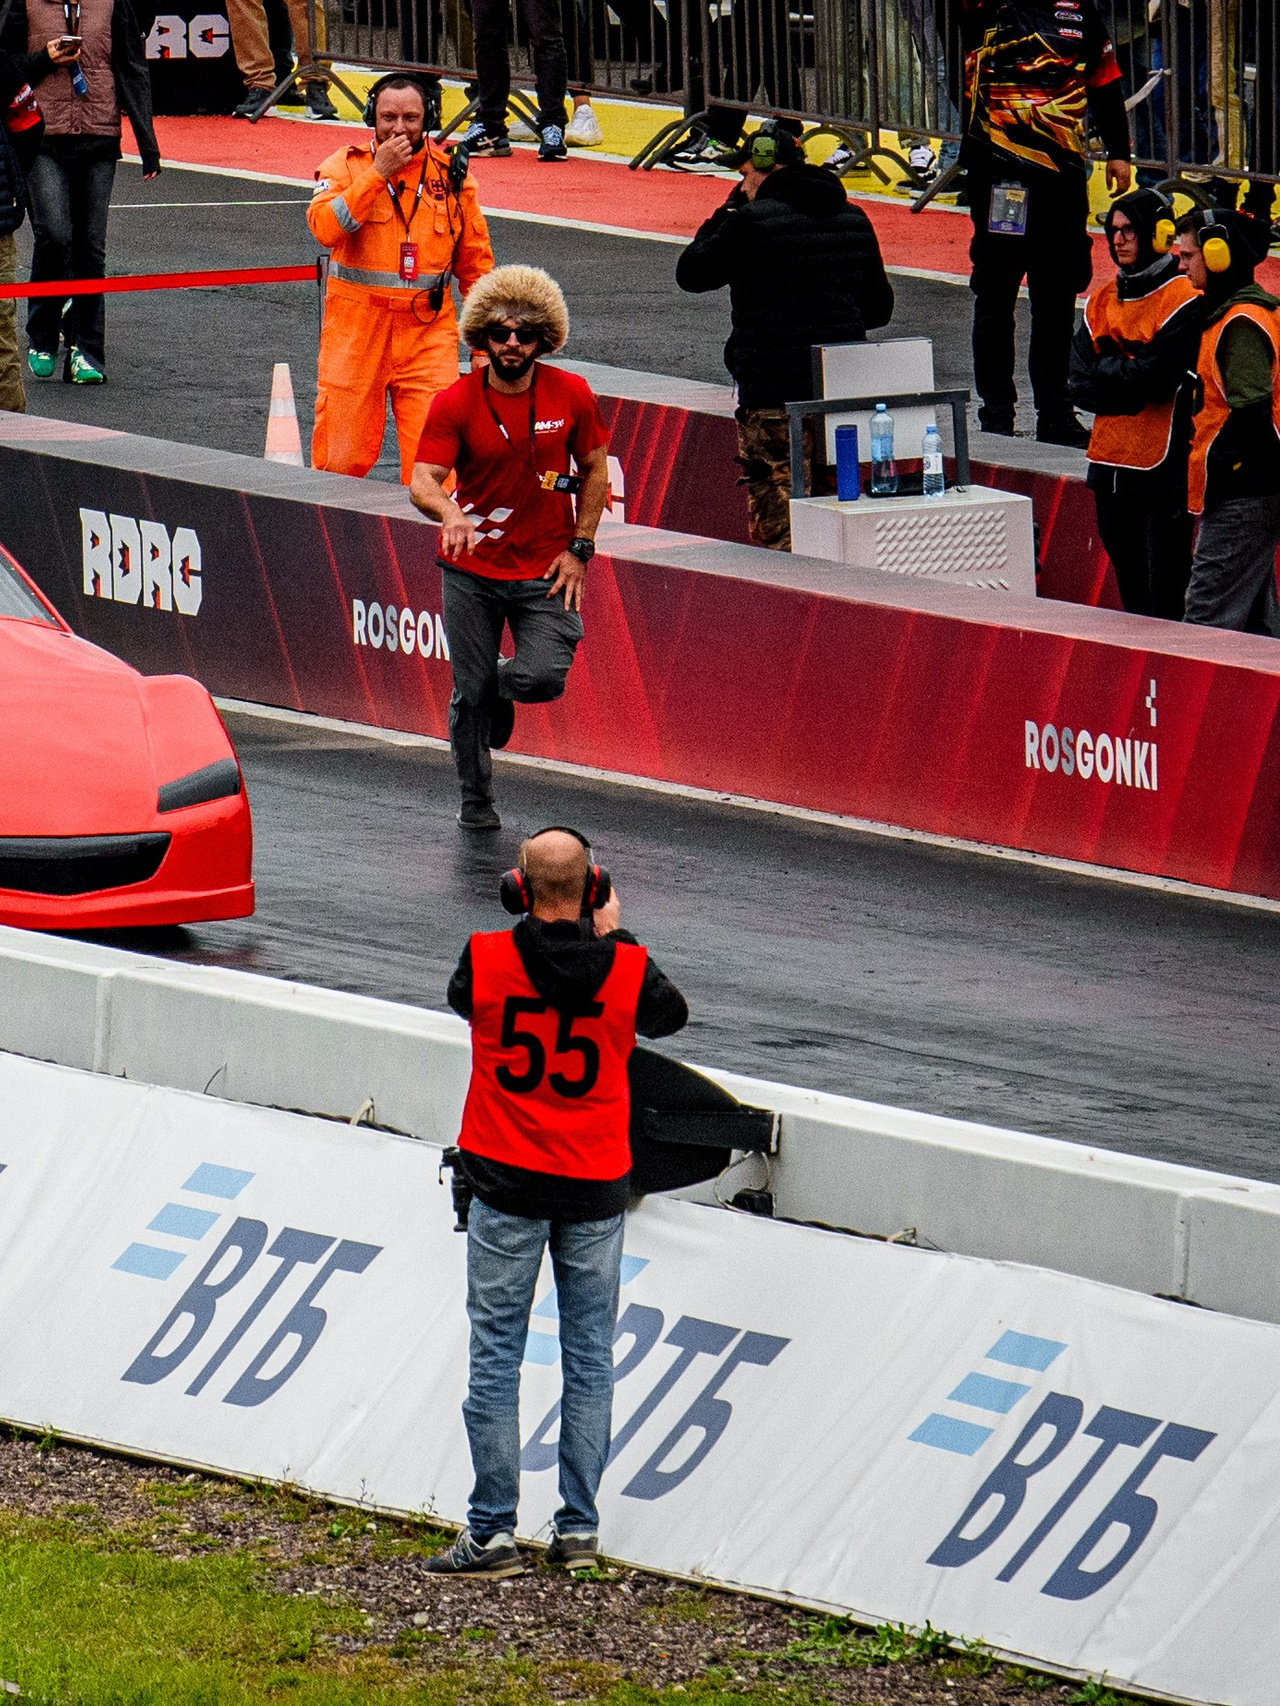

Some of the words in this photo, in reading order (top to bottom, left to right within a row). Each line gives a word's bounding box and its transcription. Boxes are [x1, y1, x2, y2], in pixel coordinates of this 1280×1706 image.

[145, 14, 229, 59] RC
[79, 507, 203, 617] RDRC
[352, 598, 451, 662] ROSGON
[1024, 719, 1159, 791] ROSGONKI
[494, 996, 606, 1099] 55
[119, 1216, 385, 1408] ВТБ
[925, 1391, 1219, 1601] ВТБ
